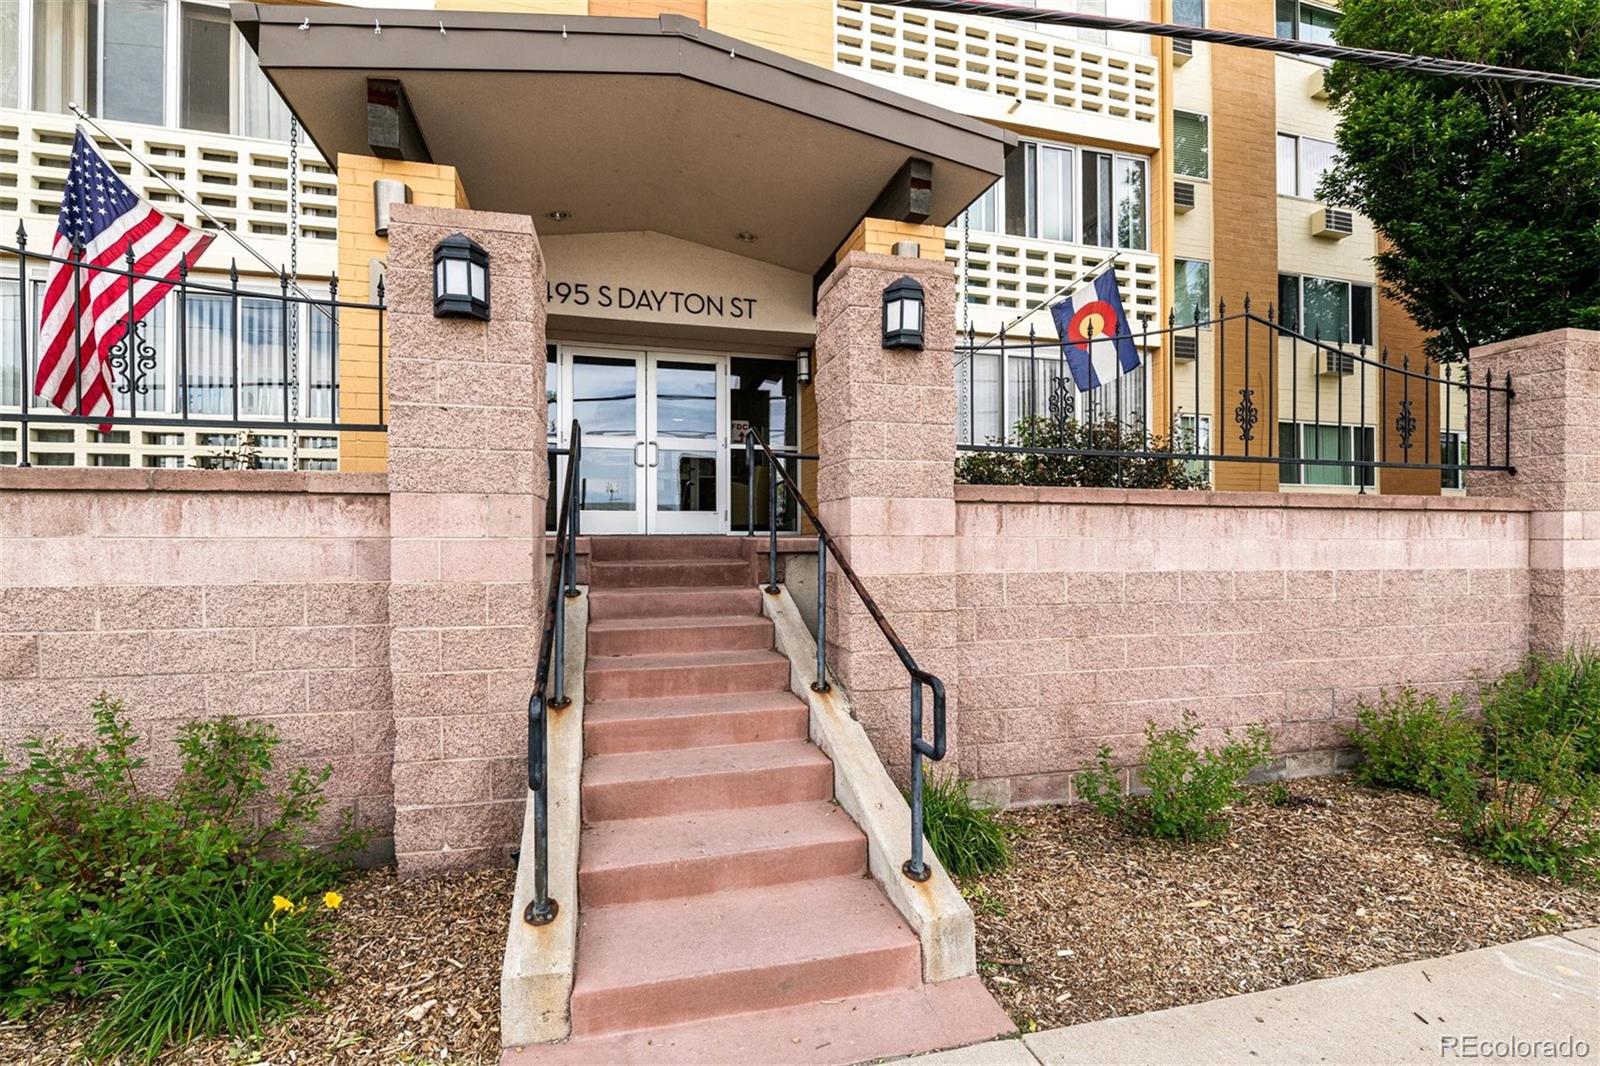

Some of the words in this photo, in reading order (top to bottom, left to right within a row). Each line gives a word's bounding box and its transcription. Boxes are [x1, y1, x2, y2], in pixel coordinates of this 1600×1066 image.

[598, 285, 613, 307] S
[618, 287, 724, 316] DAYTON
[729, 297, 758, 320] ST
